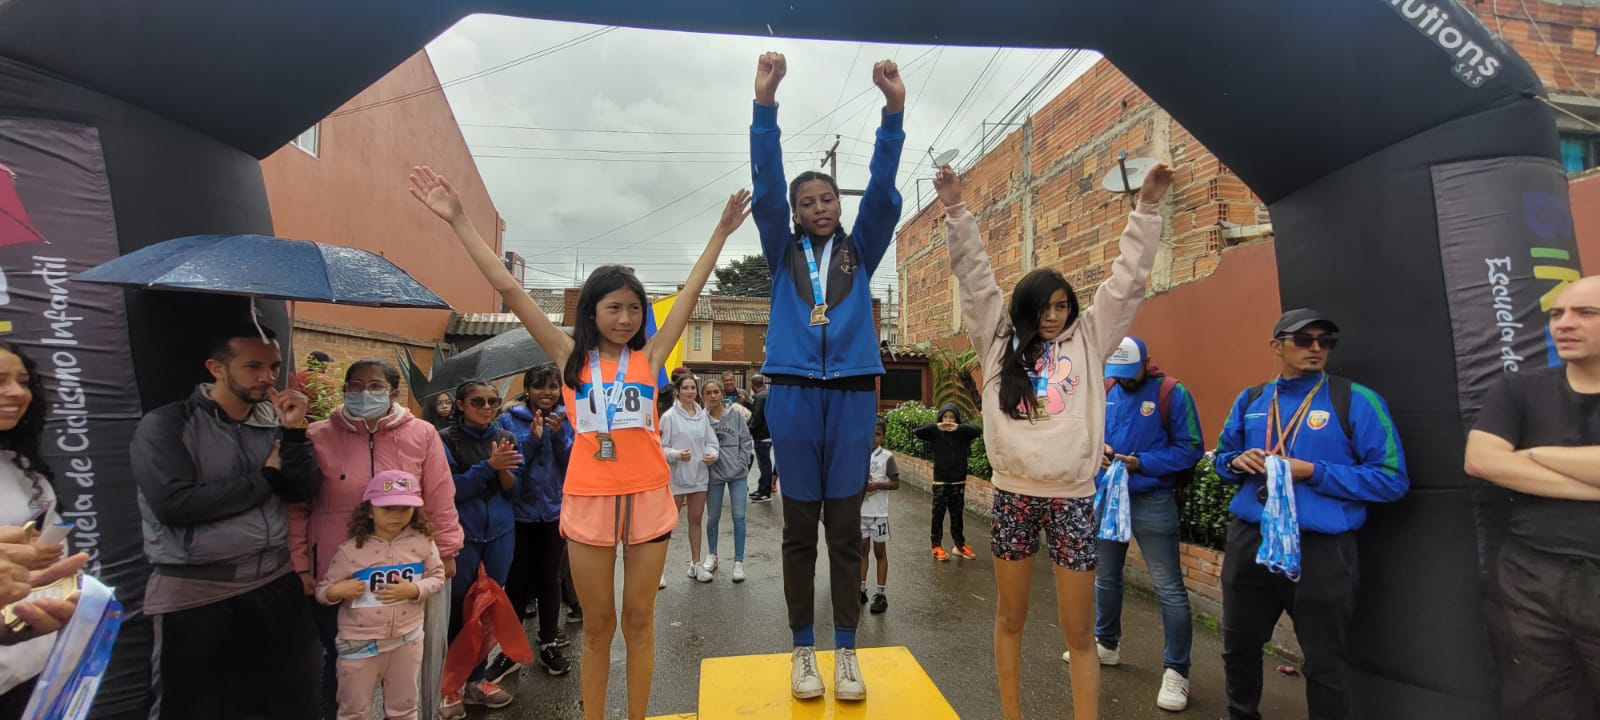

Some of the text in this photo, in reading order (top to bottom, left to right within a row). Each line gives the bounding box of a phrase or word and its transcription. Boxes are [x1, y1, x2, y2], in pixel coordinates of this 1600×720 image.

[1390, 0, 1499, 76] utions
[32, 255, 83, 345] Infantil
[1485, 256, 1524, 373] Escuela de
[52, 351, 89, 451] Ciclismo
[65, 457, 95, 487] de
